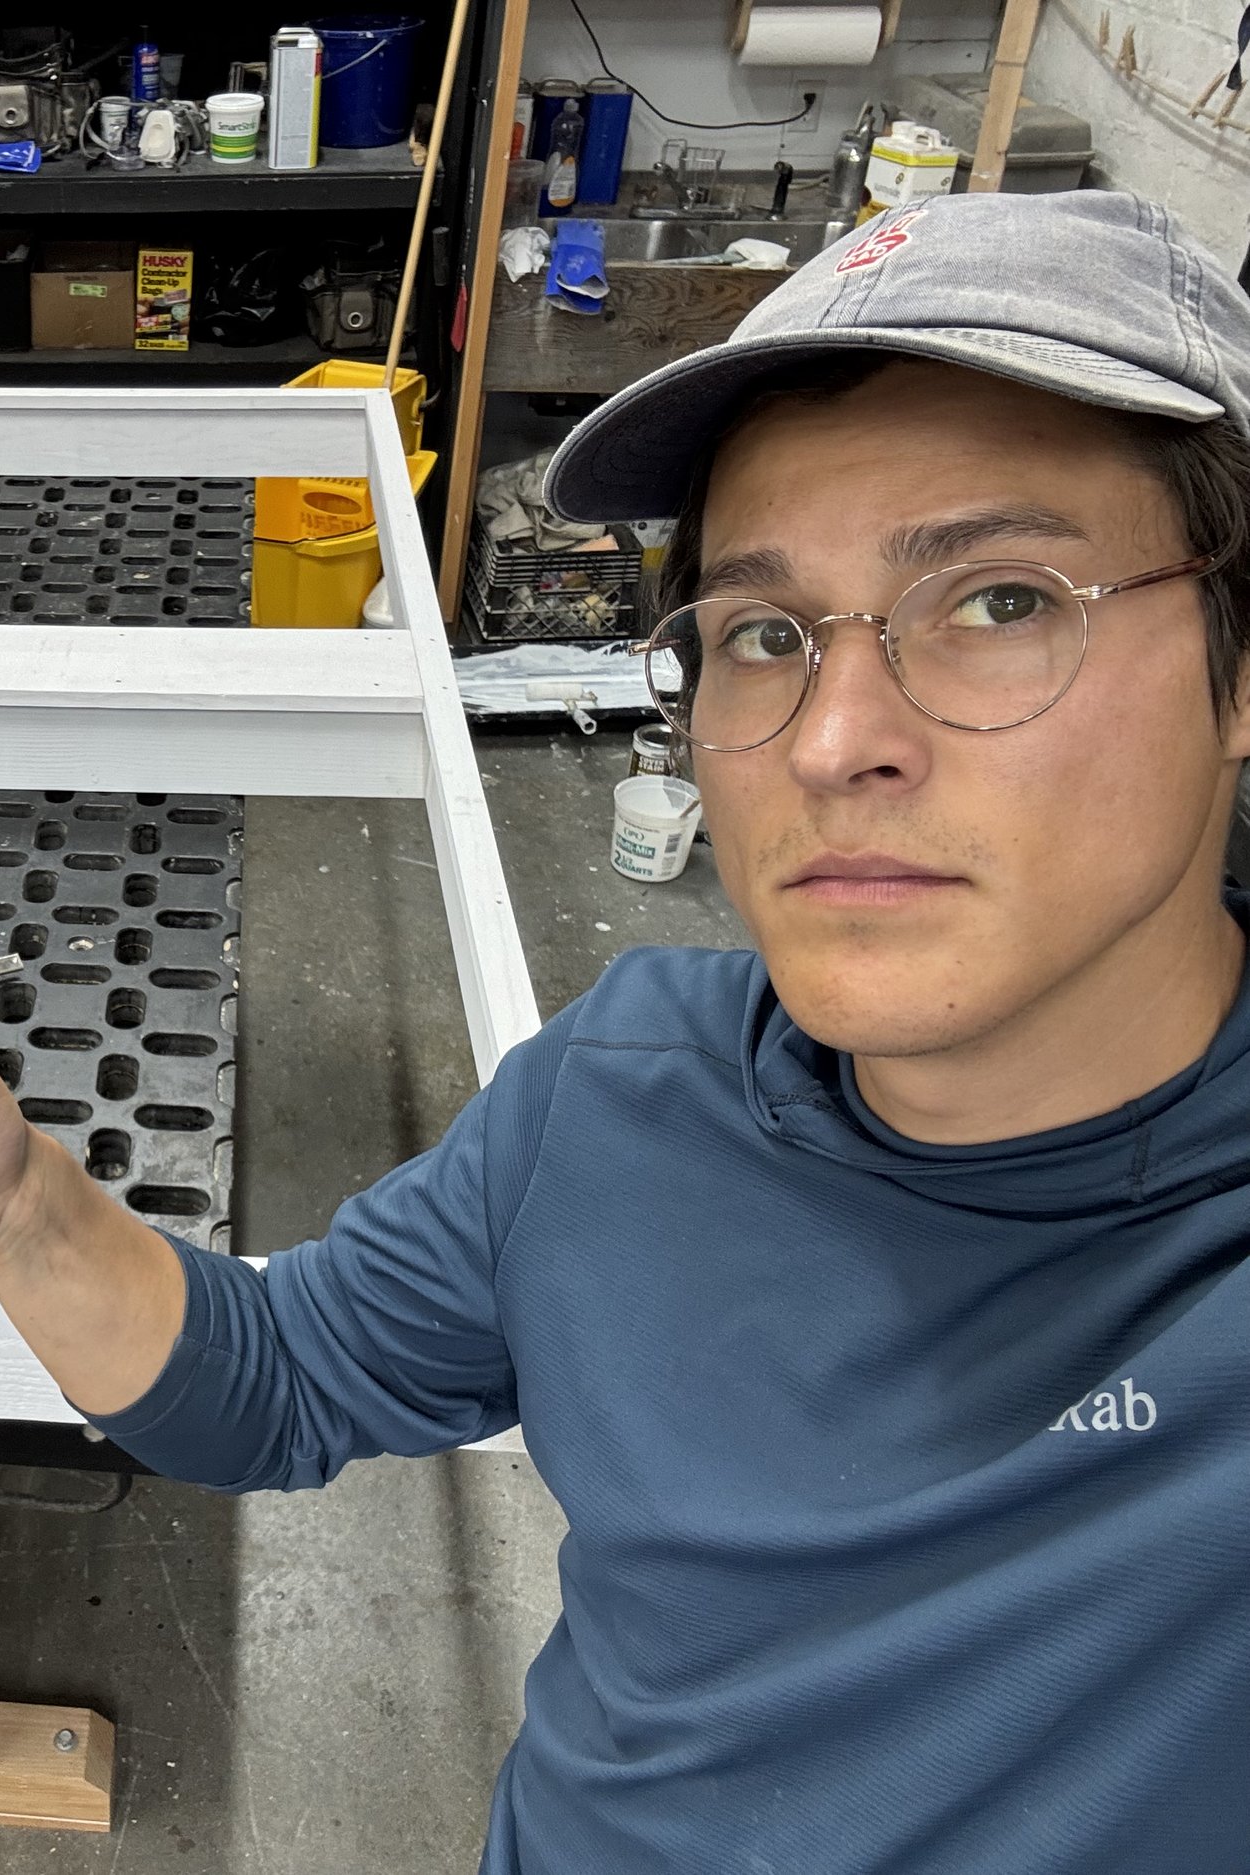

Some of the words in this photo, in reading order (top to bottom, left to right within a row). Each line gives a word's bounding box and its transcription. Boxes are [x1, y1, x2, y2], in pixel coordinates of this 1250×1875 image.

[142, 255, 187, 267] HUSKY
[141, 268, 188, 277] Contractor
[141, 277, 180, 287] Clean-Up
[141, 287, 163, 296] Bags
